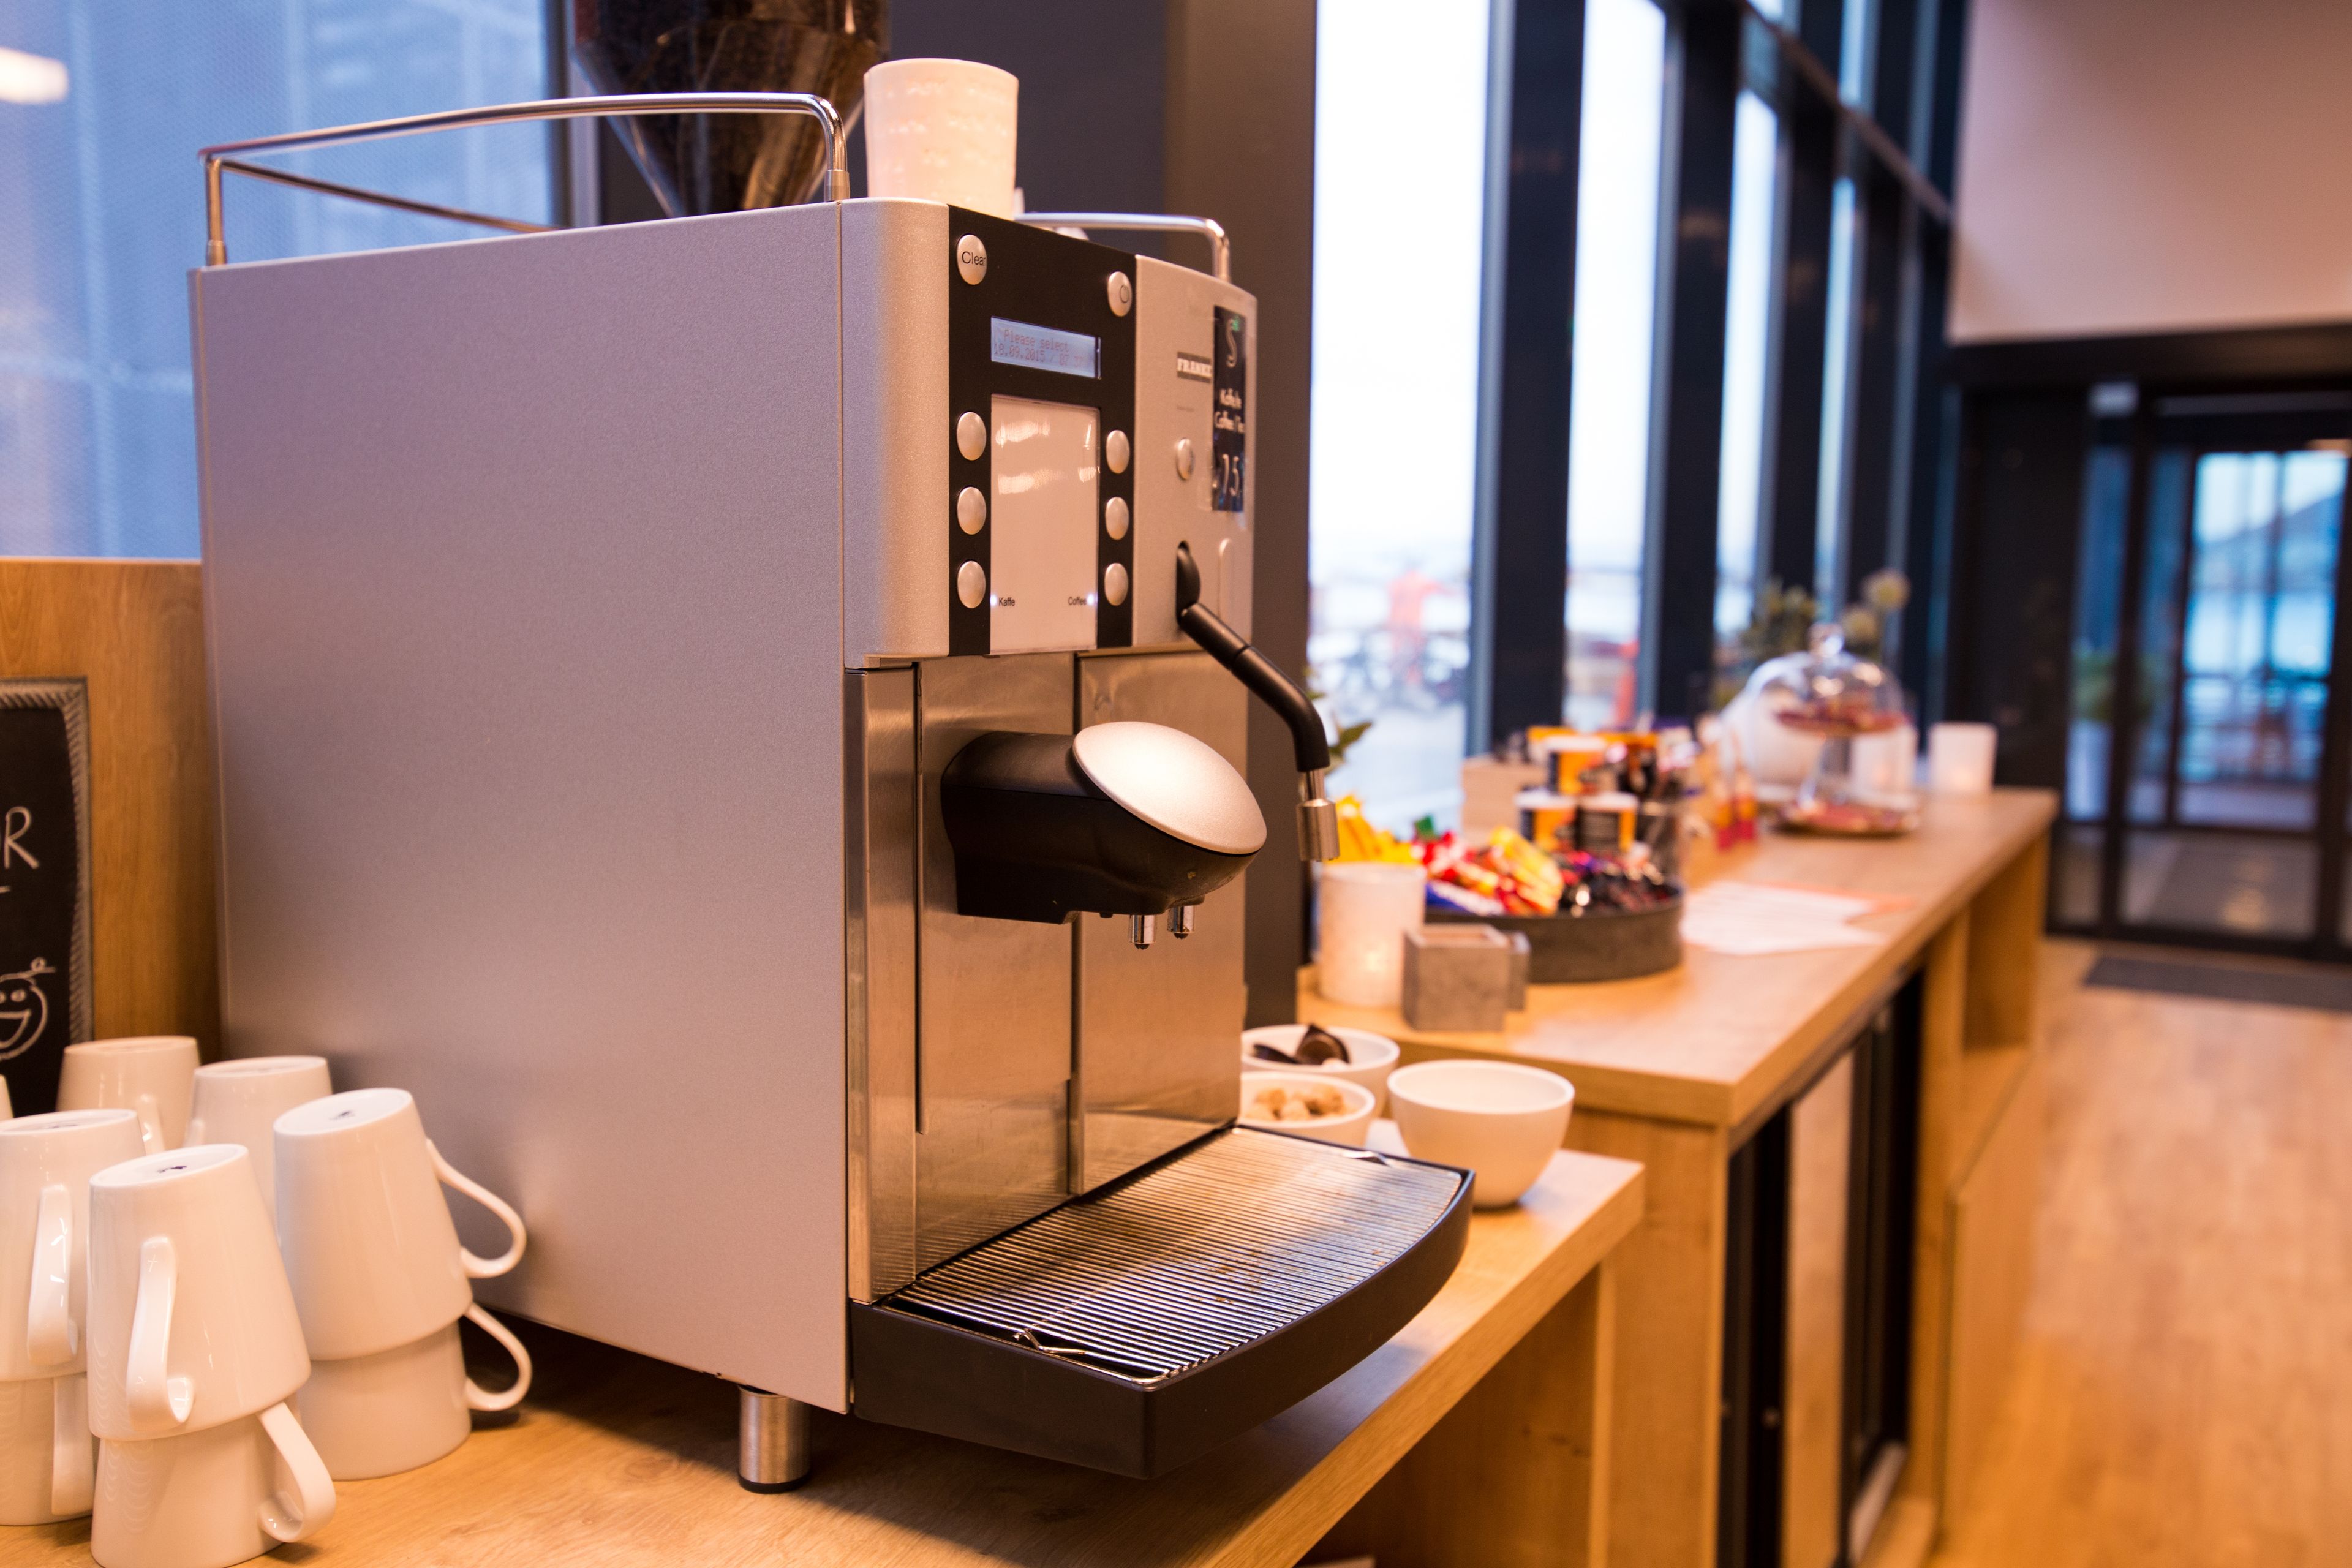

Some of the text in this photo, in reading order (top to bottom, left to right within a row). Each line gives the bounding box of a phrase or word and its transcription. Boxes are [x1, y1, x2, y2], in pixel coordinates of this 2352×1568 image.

[962, 251, 986, 265] Clear
[1004, 329, 1069, 353] Please select
[998, 597, 1016, 606] Kaffe
[1068, 597, 1087, 606] Coffee
